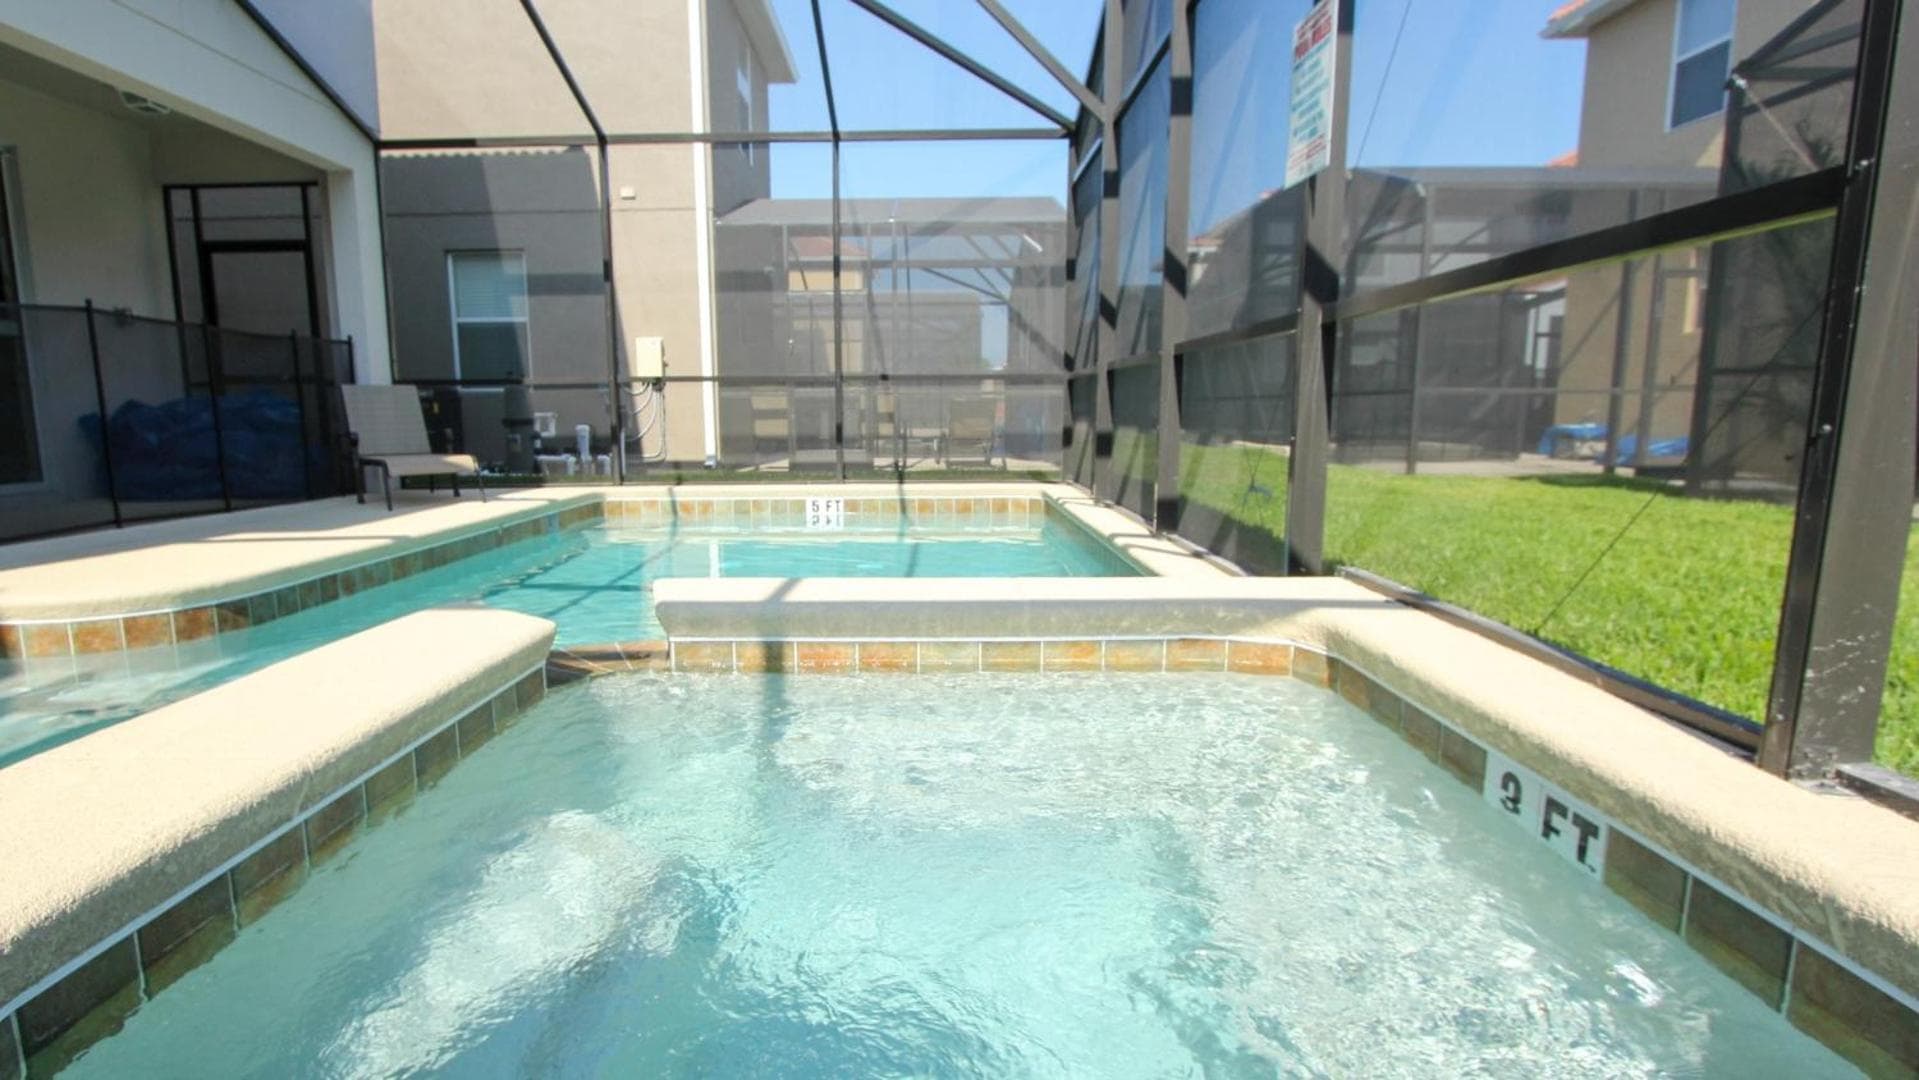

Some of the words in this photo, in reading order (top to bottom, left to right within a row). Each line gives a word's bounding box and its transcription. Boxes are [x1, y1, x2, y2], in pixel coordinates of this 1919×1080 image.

[811, 499, 820, 513] 5
[825, 499, 842, 513] FT
[1541, 795, 1599, 865] FT
